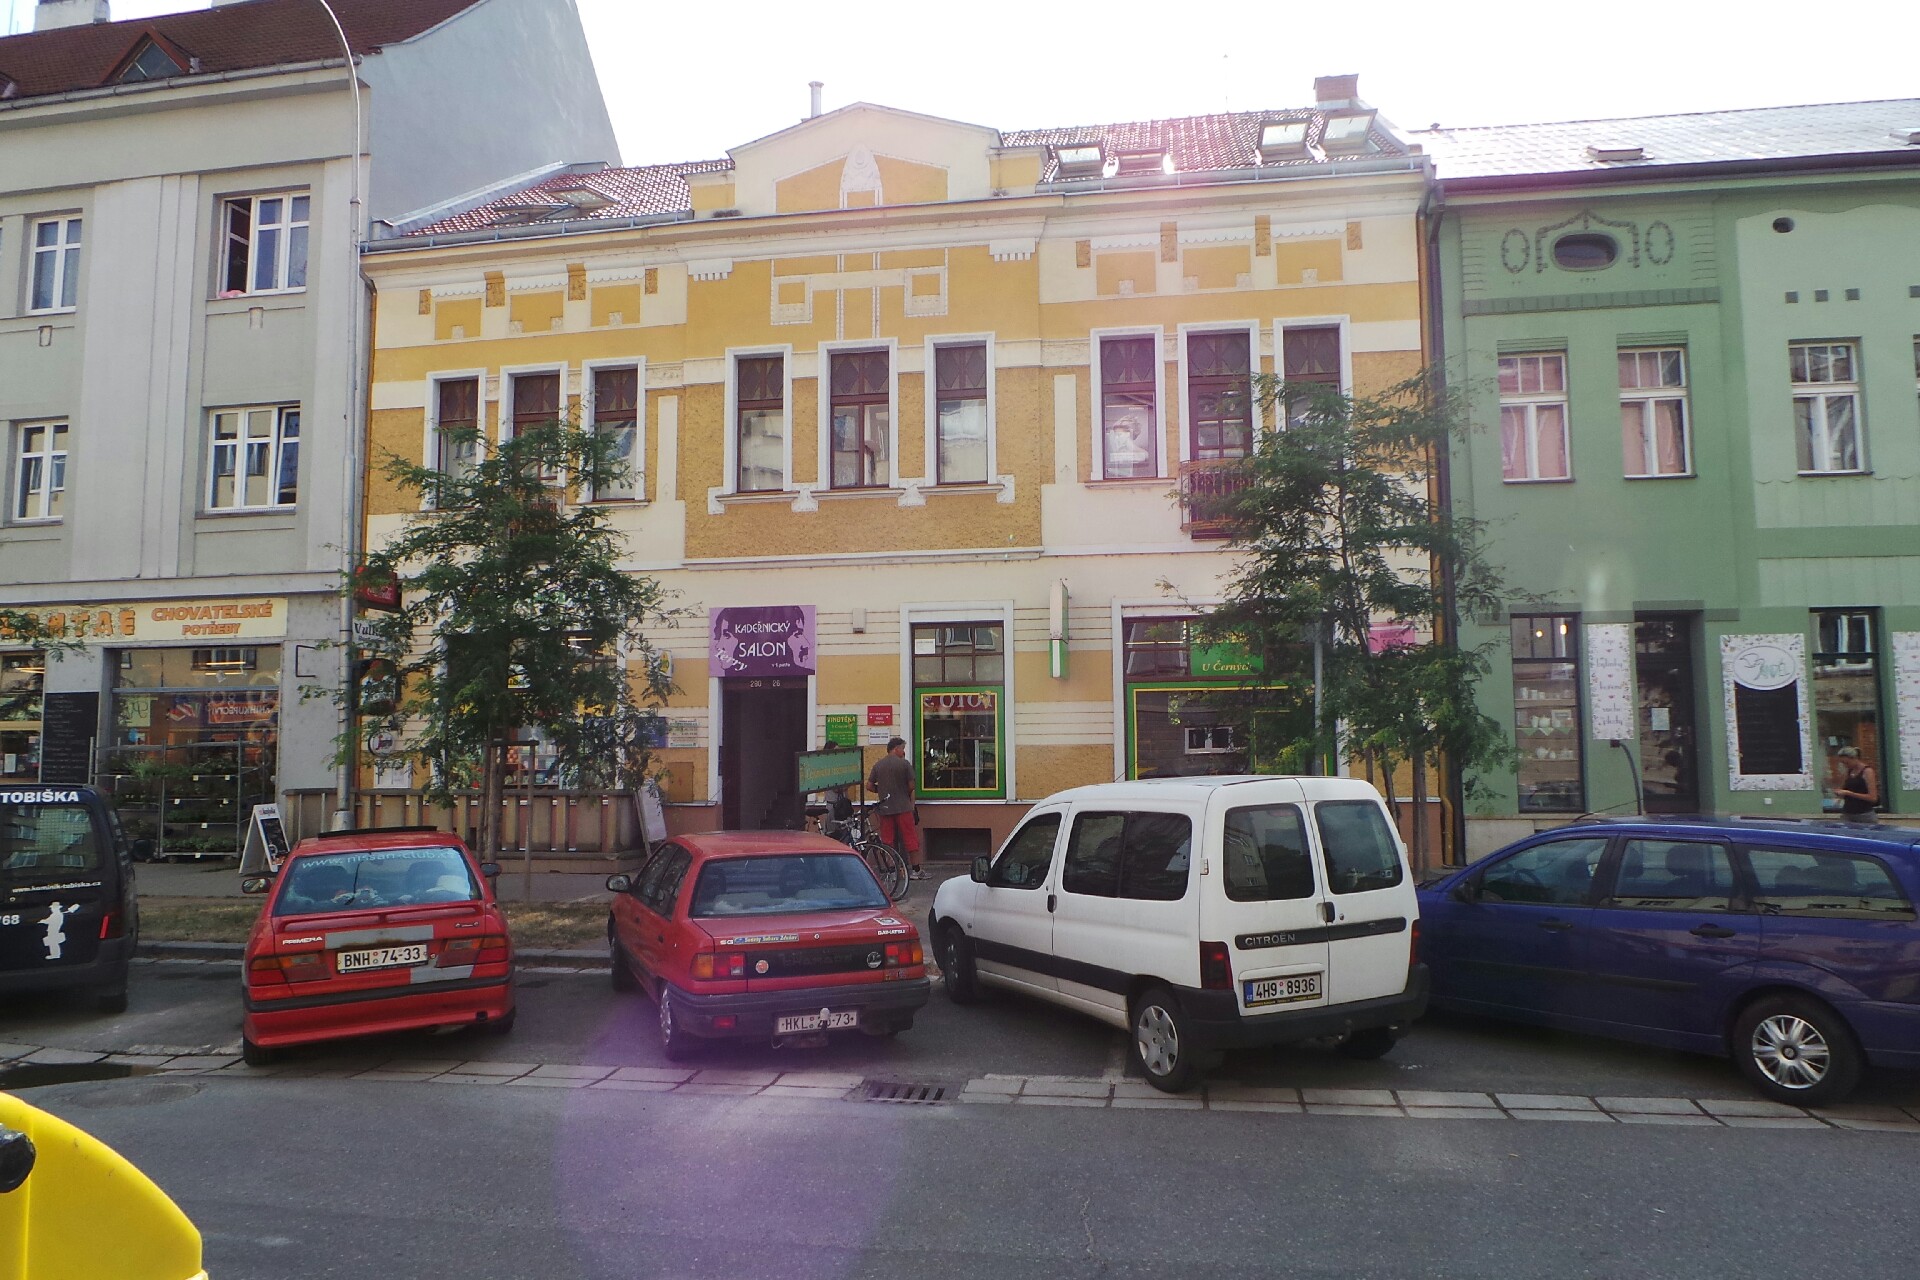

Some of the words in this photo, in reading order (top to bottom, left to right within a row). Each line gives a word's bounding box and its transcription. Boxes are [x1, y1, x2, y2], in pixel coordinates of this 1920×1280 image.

[151, 600, 273, 621] CHOVATELSKÉ
[181, 621, 241, 635] POTŘEBY
[735, 620, 791, 634] KADEŘNICKÝ
[738, 641, 786, 657] SALON
[1202, 663, 1210, 672] U
[0, 788, 79, 803] TOBIŠKA
[0, 914, 20, 925] 68
[282, 936, 323, 945] PRIMERA
[1244, 933, 1296, 946] CITROËN
[344, 953, 371, 968] BNH
[381, 947, 421, 963] 74-33
[1256, 982, 1278, 999] 4H9
[1286, 977, 1316, 995] 8936
[785, 1017, 808, 1031] HKL
[817, 1013, 851, 1029] 2-73
